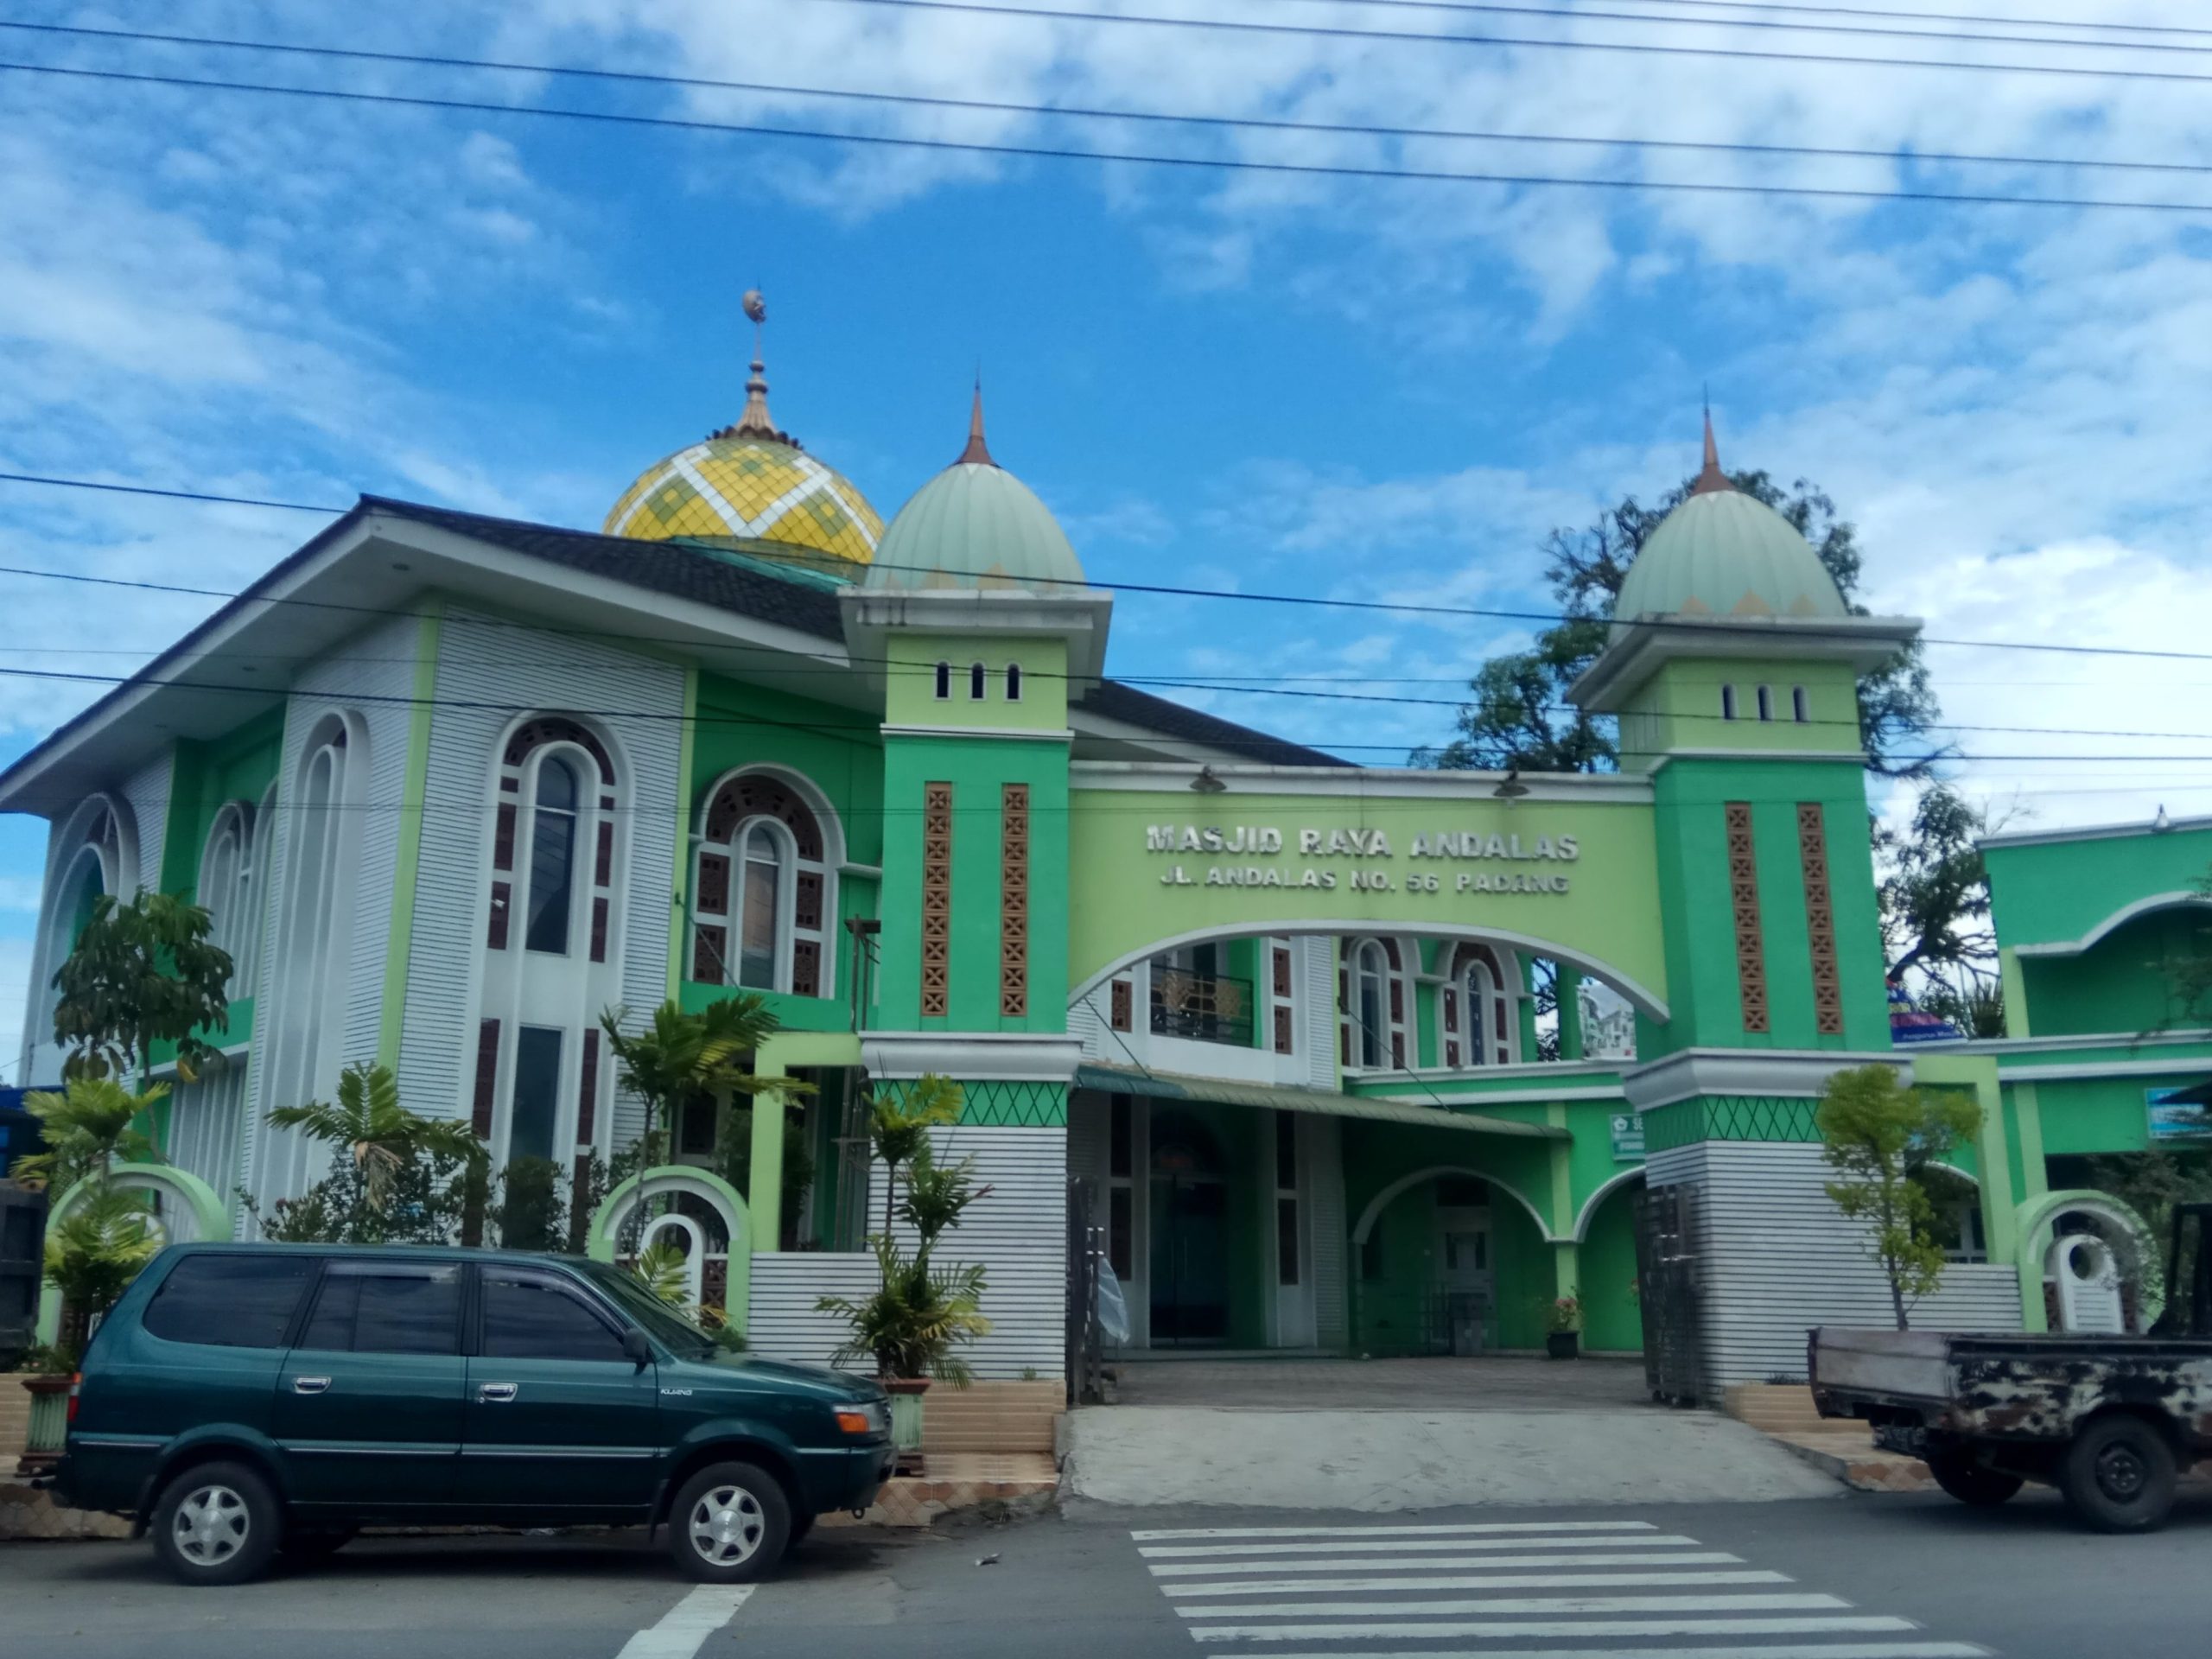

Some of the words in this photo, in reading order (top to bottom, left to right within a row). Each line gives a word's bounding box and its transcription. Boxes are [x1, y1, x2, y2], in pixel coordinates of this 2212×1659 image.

[1147, 824, 1283, 854] MASJID
[1299, 829, 1393, 858] RAYA
[1409, 832, 1580, 861] ANDALAS
[1160, 866, 1198, 887] JL.
[1205, 867, 1338, 889] ANDALAS
[1350, 869, 1396, 892] NO.
[1406, 873, 1440, 893] 56
[1456, 873, 1570, 894] PADANG
